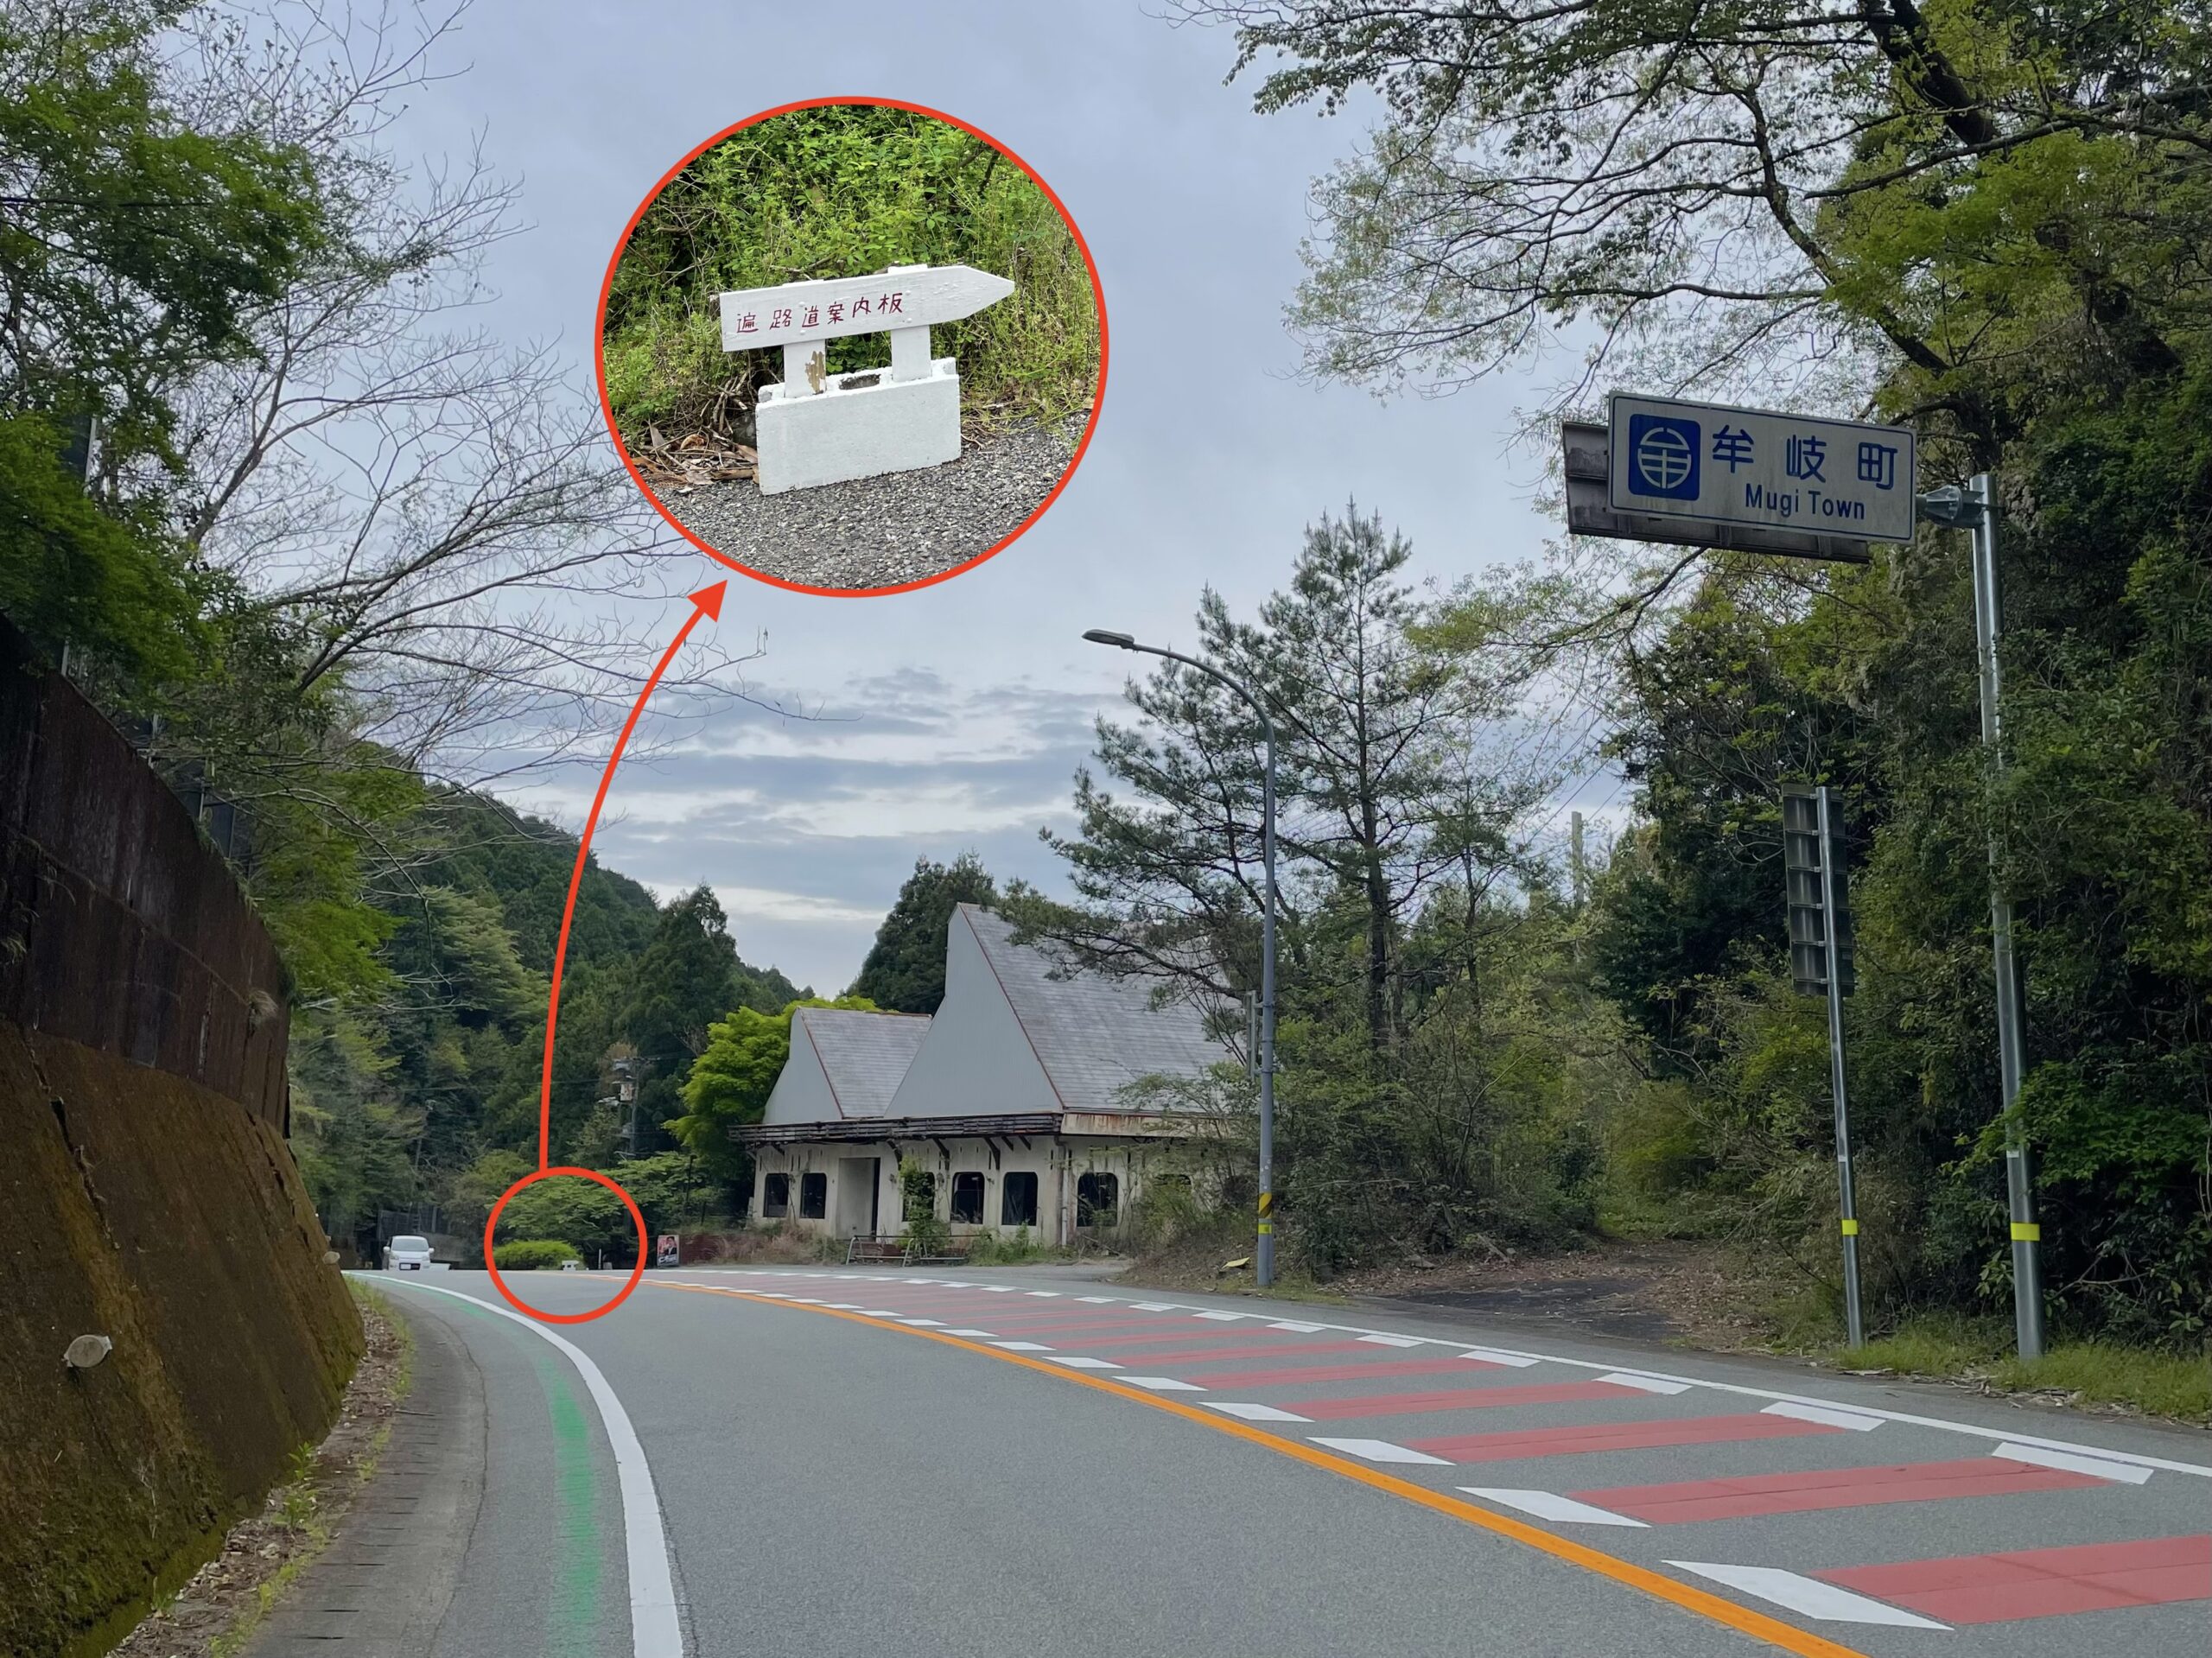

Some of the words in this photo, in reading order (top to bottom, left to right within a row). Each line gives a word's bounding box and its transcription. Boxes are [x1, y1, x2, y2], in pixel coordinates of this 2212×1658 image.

[736, 292, 903, 333] 遍路道案内板
[1712, 424, 1897, 490] 牟岐町
[1745, 483, 1799, 517] Mugi
[1808, 491, 1865, 519] Town
